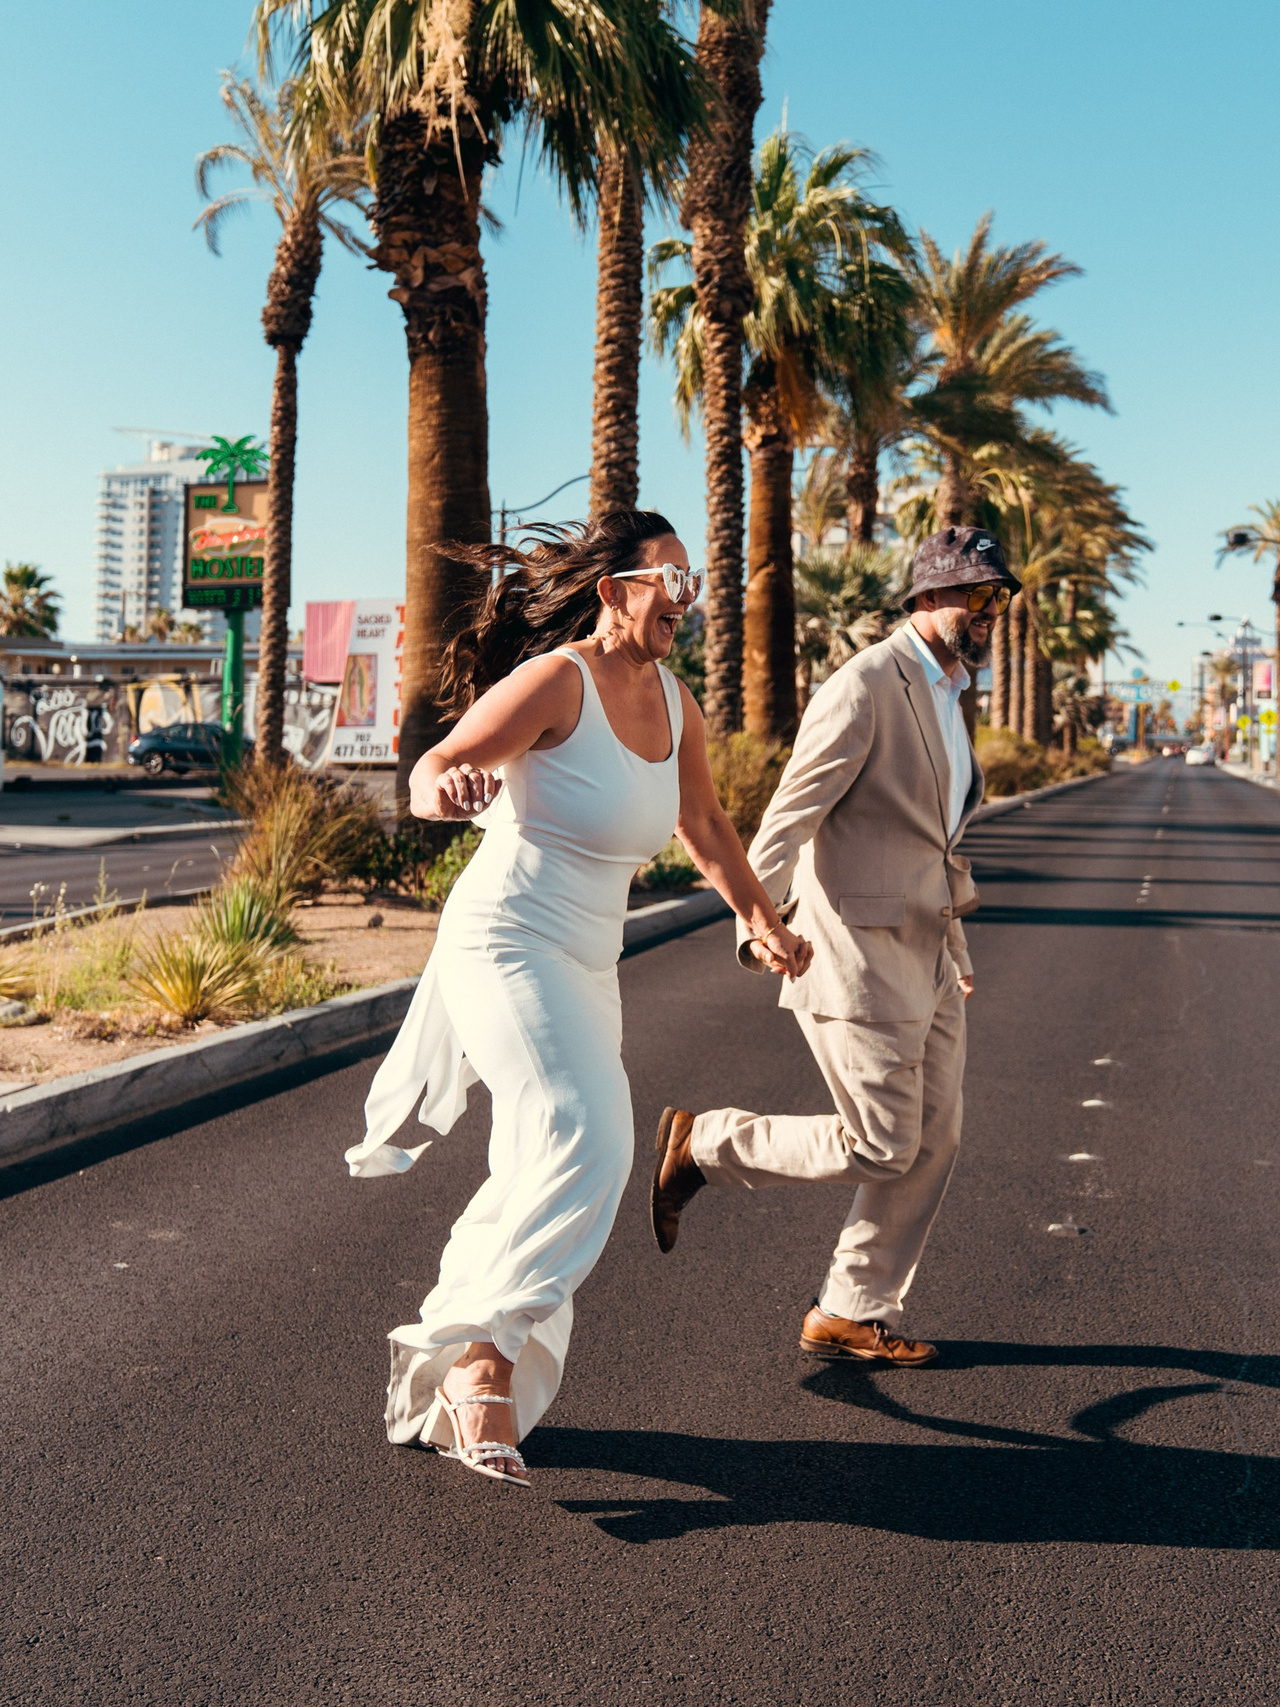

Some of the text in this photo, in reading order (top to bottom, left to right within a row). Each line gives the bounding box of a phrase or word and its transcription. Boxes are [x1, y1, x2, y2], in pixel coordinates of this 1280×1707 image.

[194, 494, 217, 509] THE
[190, 556, 265, 579] HOSTEL
[357, 614, 392, 625] SACRED
[356, 628, 386, 639] HEART
[334, 744, 390, 758] 477-0757
